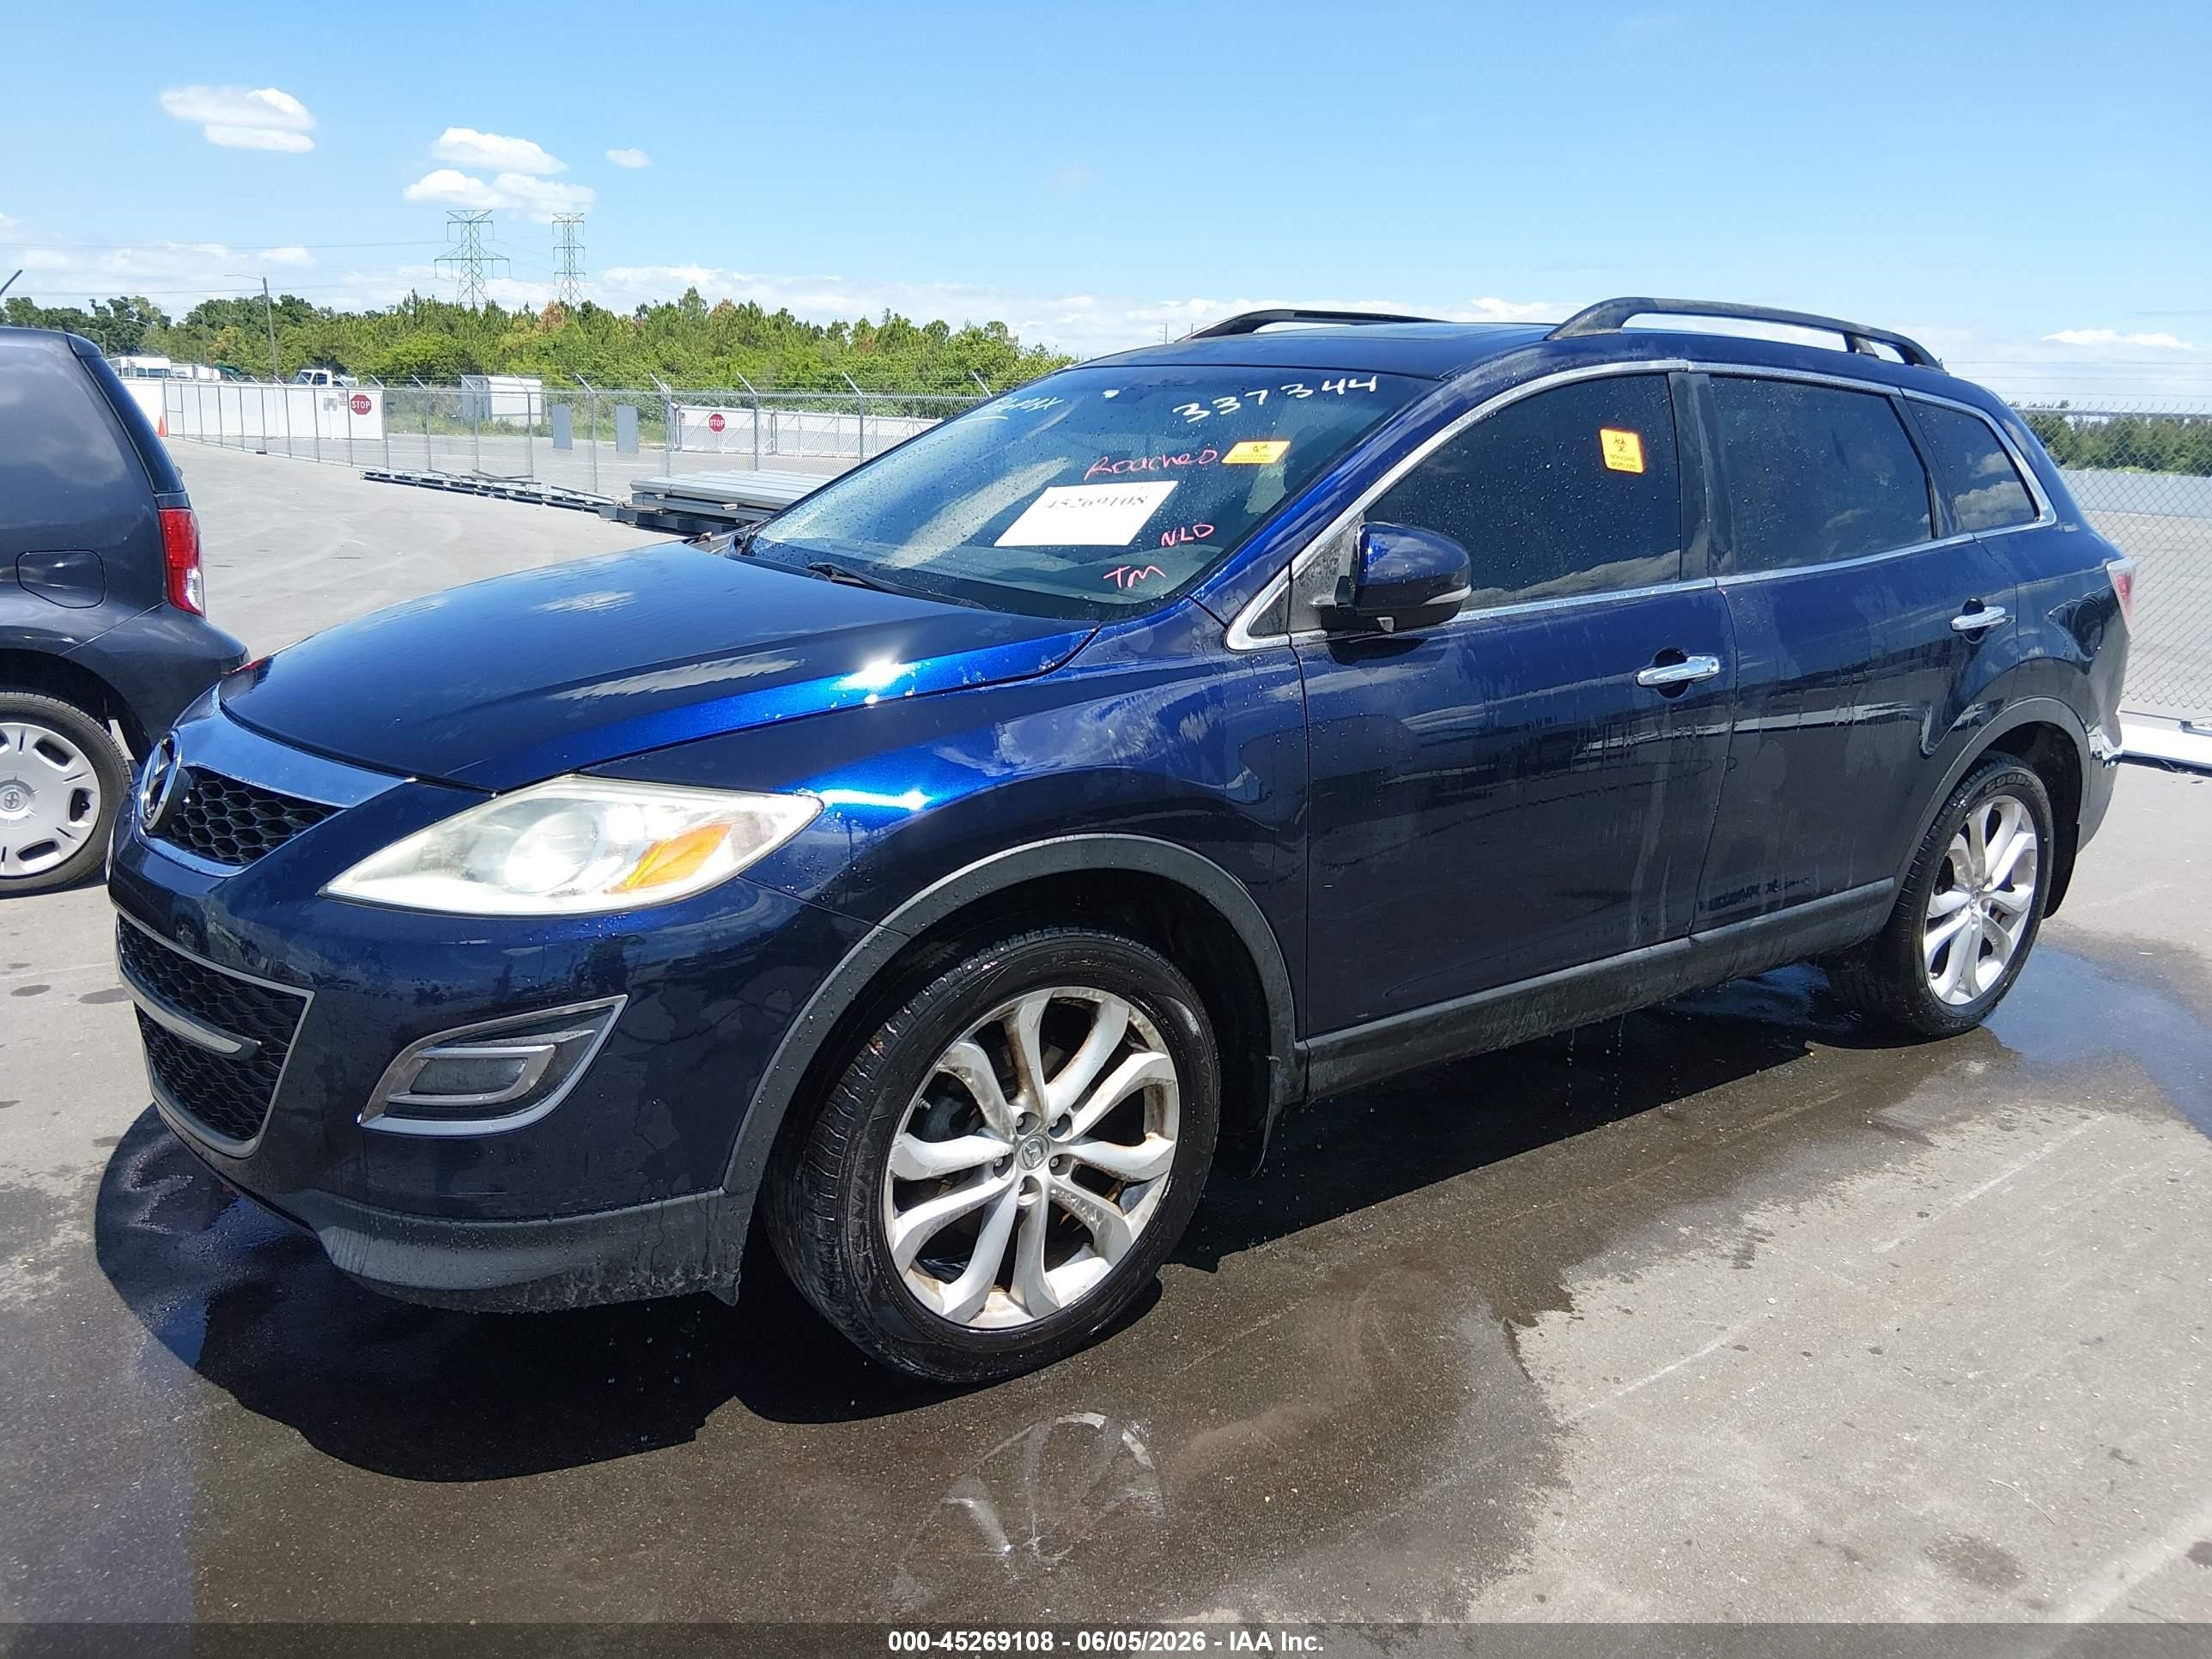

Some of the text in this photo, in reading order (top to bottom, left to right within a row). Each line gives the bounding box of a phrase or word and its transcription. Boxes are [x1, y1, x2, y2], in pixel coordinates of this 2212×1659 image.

[351, 400, 371, 410] STOP
[1173, 375, 1377, 423] 337344
[709, 418, 725, 428] STOP
[1161, 523, 1214, 547] NLD
